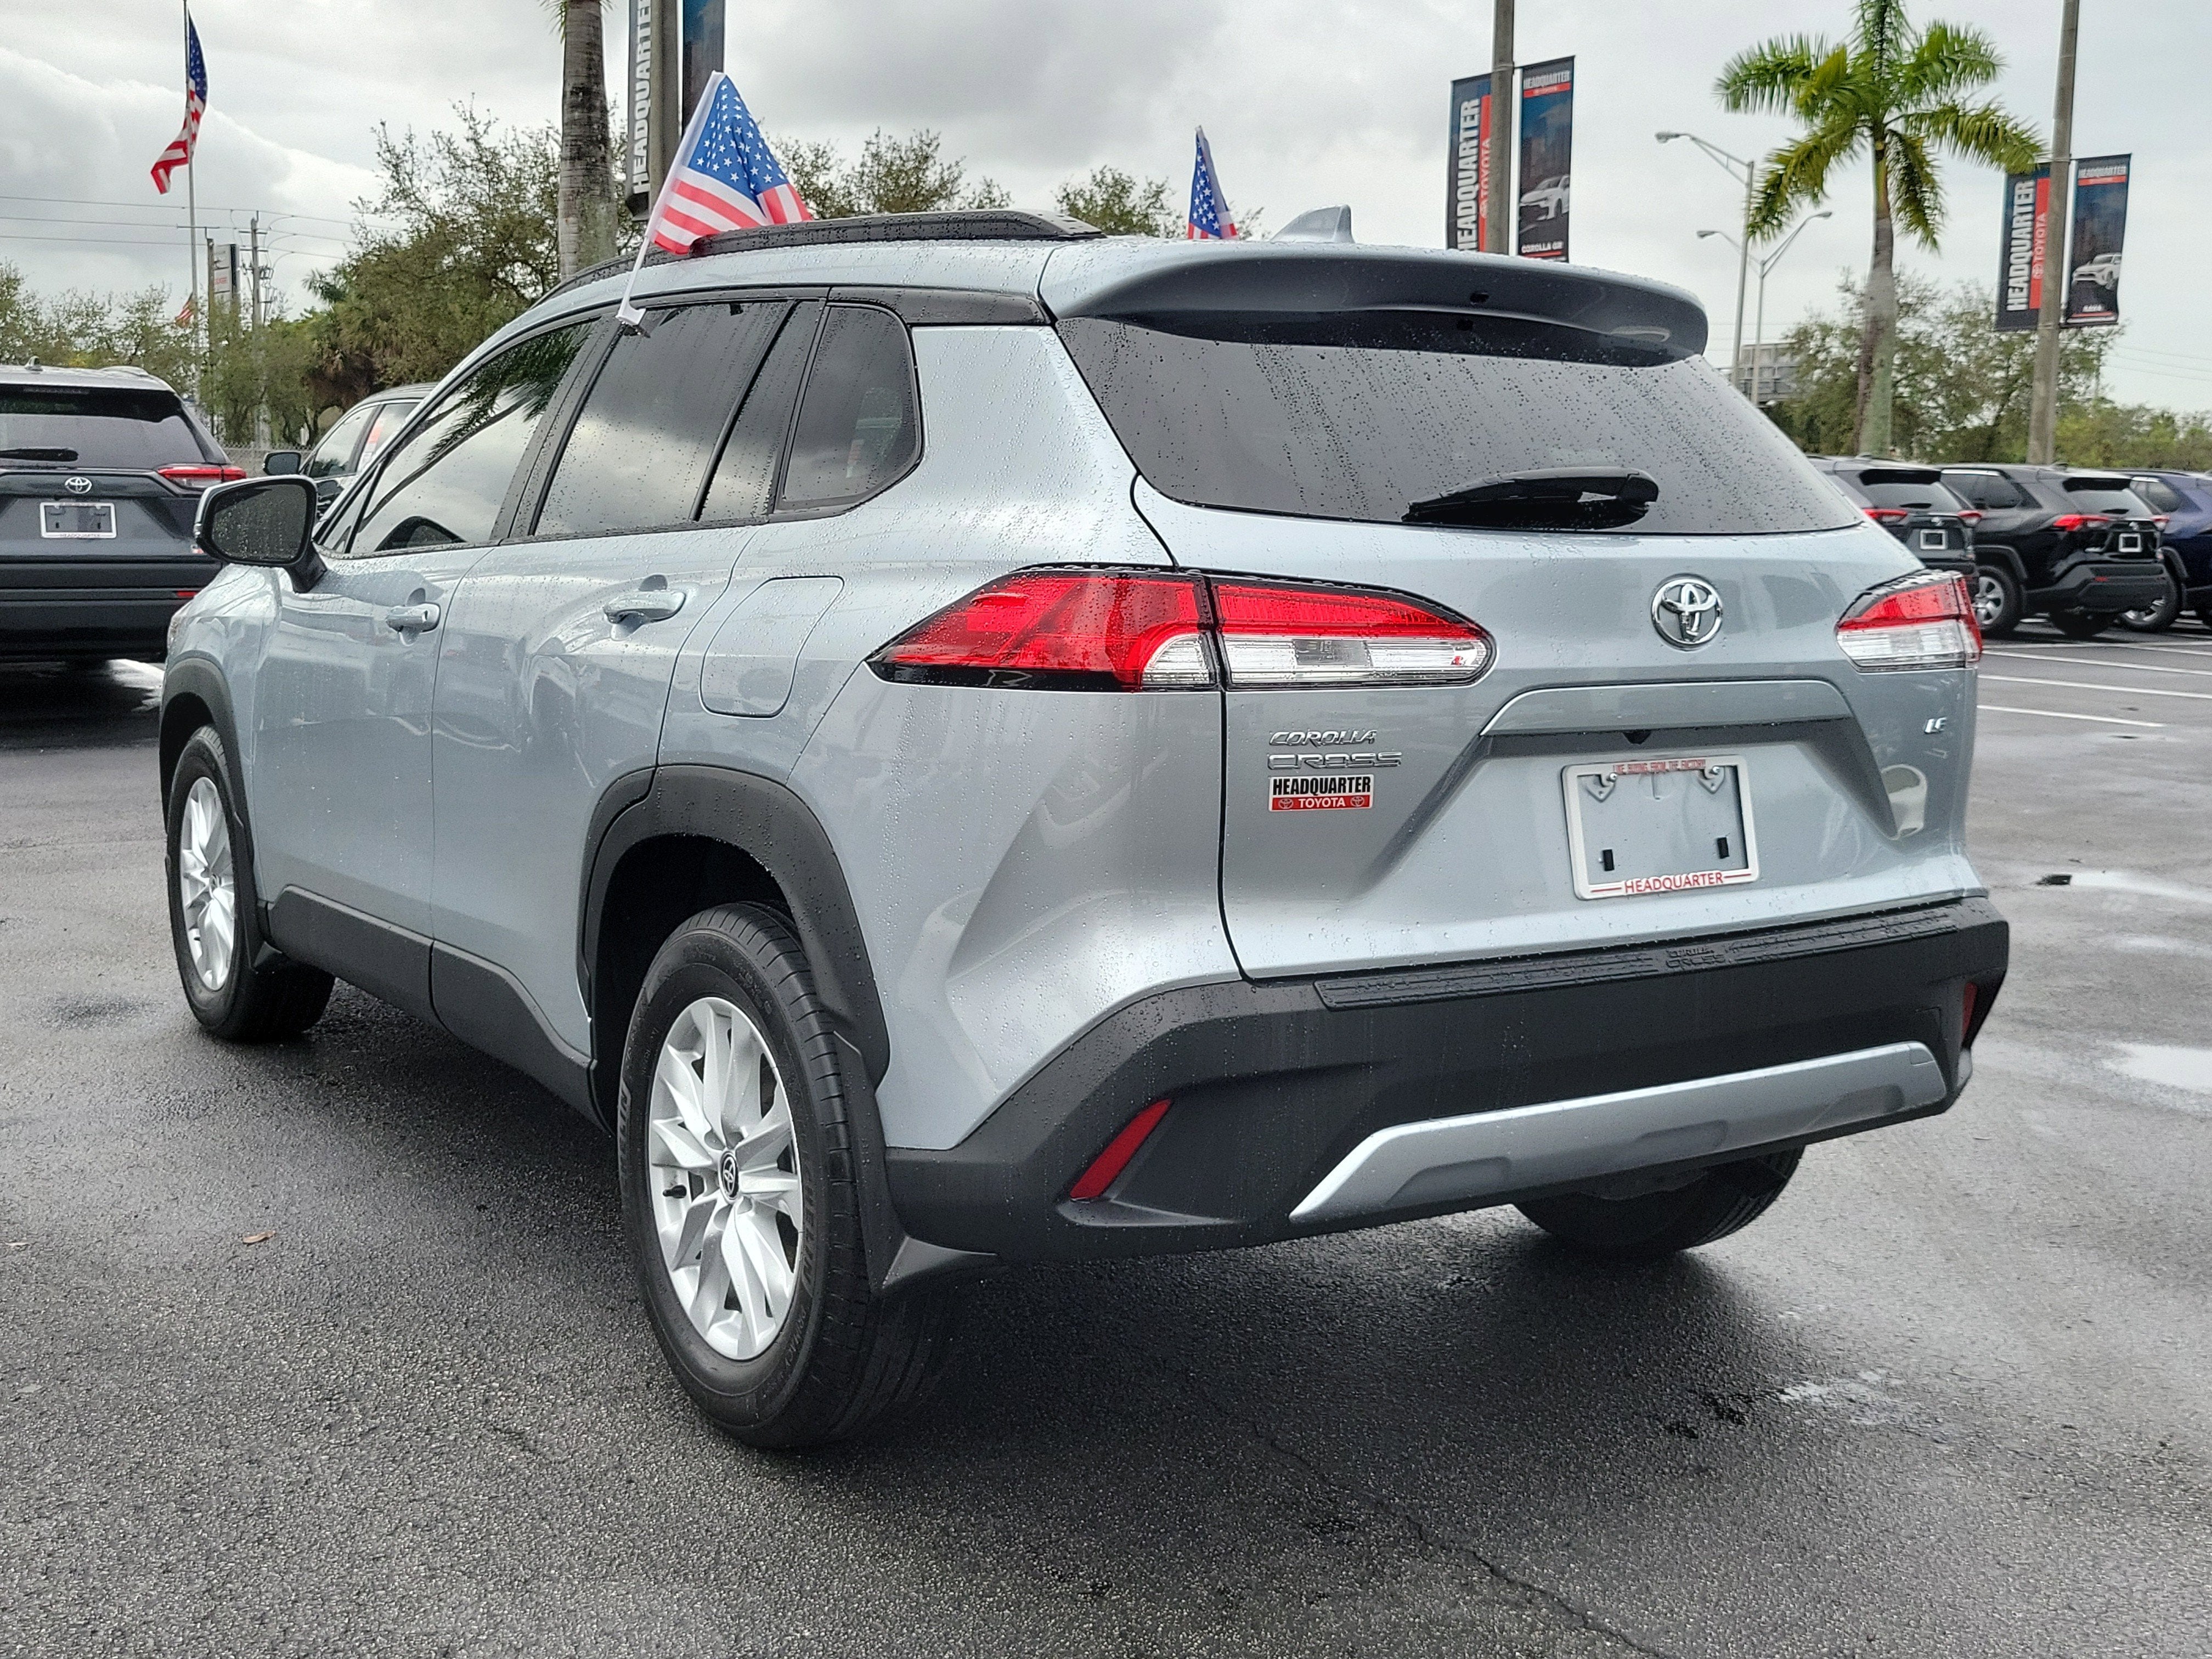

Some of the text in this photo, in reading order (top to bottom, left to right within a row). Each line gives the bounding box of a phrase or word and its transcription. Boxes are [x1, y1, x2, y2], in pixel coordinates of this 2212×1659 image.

[2006, 179, 2035, 311] HEADQUARTER
[2033, 212, 2048, 262] TOYOTA
[1924, 717, 1948, 734] LE
[1269, 729, 1377, 747] COROLLA
[1267, 751, 1402, 770] CROSS
[1272, 776, 1371, 795] HEADQUARTER
[1298, 797, 1346, 808] TOYOTA
[1624, 872, 1724, 893] HEADQUARTER
